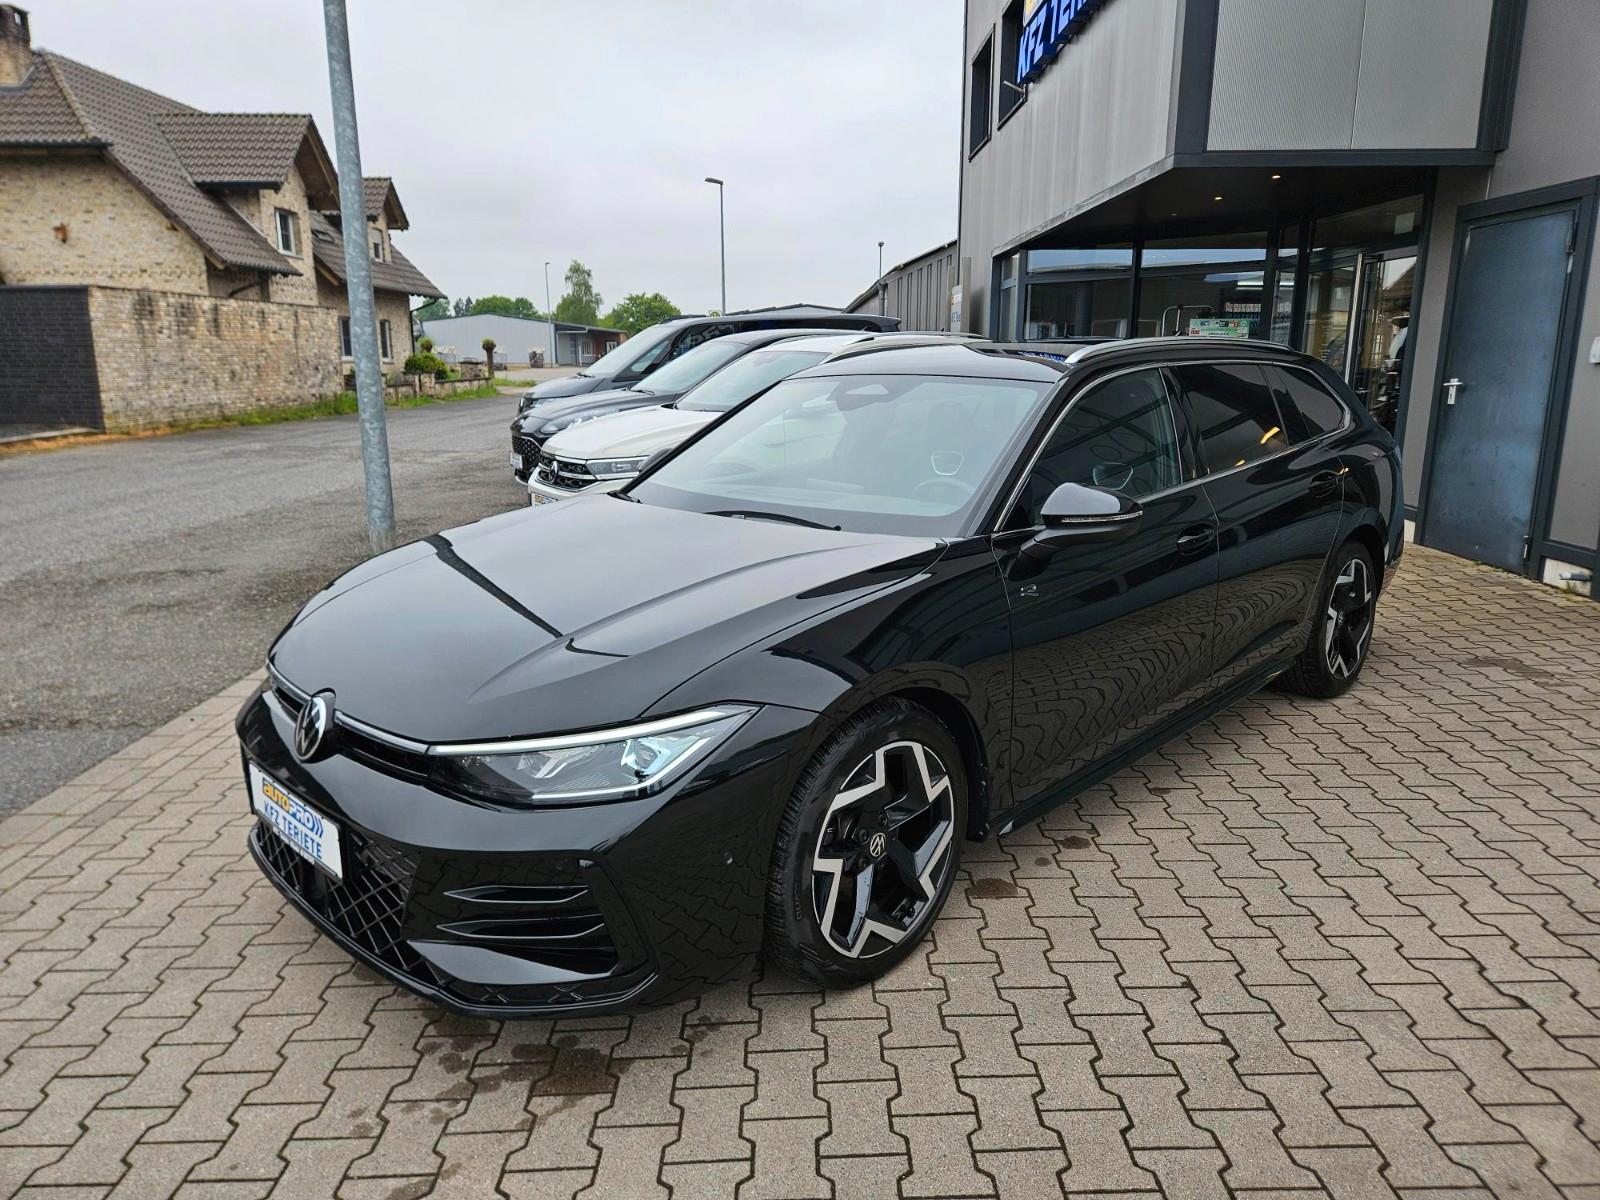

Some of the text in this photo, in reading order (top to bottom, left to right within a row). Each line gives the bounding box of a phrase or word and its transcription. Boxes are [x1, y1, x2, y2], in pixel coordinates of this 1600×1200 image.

[1017, 3, 1047, 83] KFZ
[264, 800, 322, 860] KFZ TERIETE
